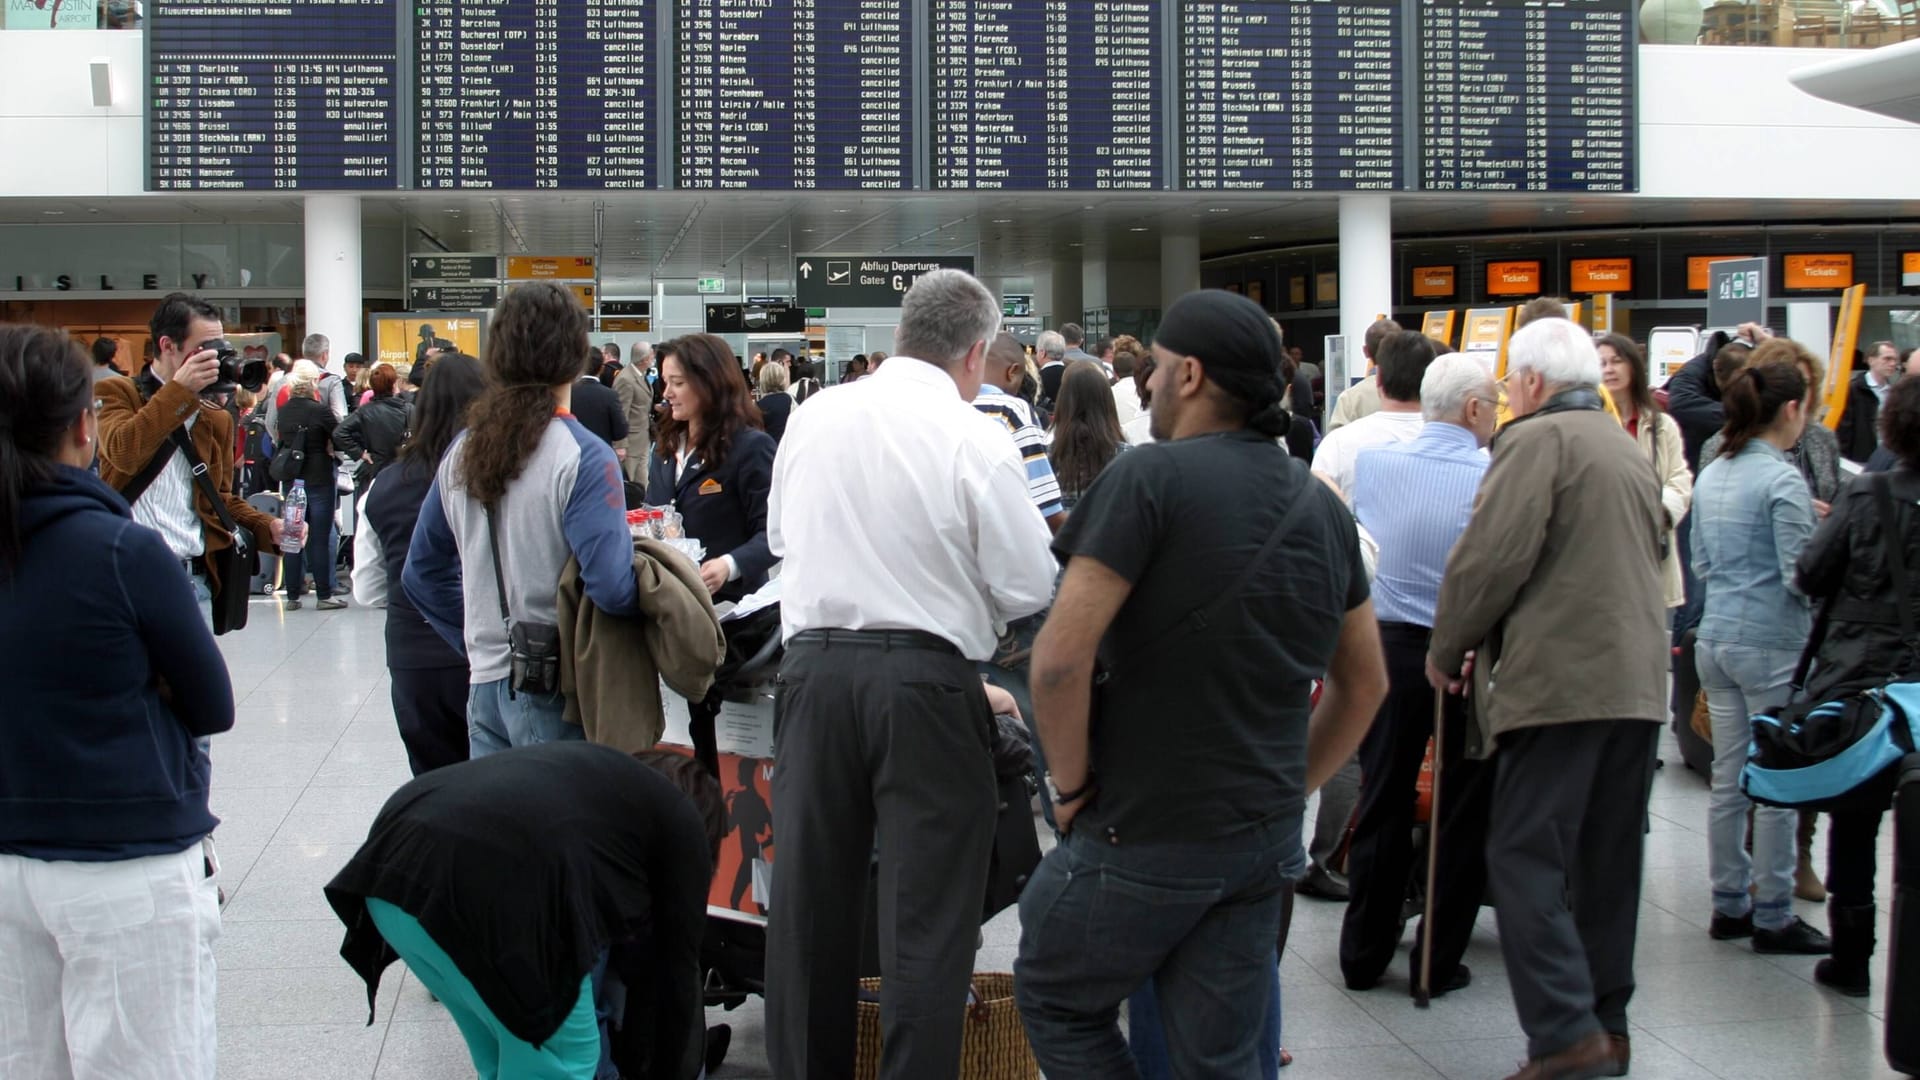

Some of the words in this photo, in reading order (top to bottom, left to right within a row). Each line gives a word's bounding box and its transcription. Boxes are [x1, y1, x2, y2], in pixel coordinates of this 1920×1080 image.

[59, 15, 91, 23] AIRPORT
[440, 19, 452, 27] 132
[535, 19, 557, 28] 13:15
[681, 32, 691, 40] LH
[698, 32, 712, 40] 940
[720, 33, 759, 41] Nuremberg
[793, 33, 815, 41] 14:35
[936, 34, 946, 43] LH
[949, 34, 967, 43] 4074
[974, 35, 1009, 43] Florence
[1046, 35, 1067, 44] 15:00
[1111, 36, 1149, 44] Lufthansa
[1424, 30, 1433, 38] LH
[1586, 33, 1622, 41] cancelled
[421, 42, 431, 50] LH
[460, 42, 504, 50] Dusseldorf
[536, 42, 557, 51] 13:15
[1185, 37, 1194, 45] LH
[1197, 37, 1215, 45] 3144
[1221, 37, 1239, 45] Oslo
[1291, 38, 1311, 47] 15:15
[1424, 40, 1433, 48] LH
[1459, 41, 1484, 49] Prague
[1586, 44, 1622, 52] cancelled
[421, 53, 431, 61] LH
[435, 53, 453, 61] 1270
[536, 54, 557, 62] 13:15
[159, 65, 169, 73] LH
[198, 65, 239, 73] Charlotte
[301, 65, 322, 73] 13:45
[343, 65, 383, 73] Lufthansa
[937, 68, 946, 76] LH
[950, 68, 967, 76] 1072
[975, 68, 1005, 77] Dresden
[1047, 69, 1067, 77] 15:05
[1112, 70, 1150, 78] cancelled
[681, 77, 691, 85] LH
[694, 77, 712, 86] 3114
[720, 78, 754, 86] Helsinki
[794, 78, 815, 86] 14:45
[861, 79, 900, 87] cancelled
[439, 87, 452, 96] 327
[536, 88, 557, 96] 13:35
[604, 88, 635, 96] 304-310
[159, 99, 169, 107] TP
[176, 99, 191, 107] 557
[274, 99, 296, 107] 12:55
[159, 111, 169, 119] LH
[199, 111, 222, 119] Sofia
[274, 110, 296, 119] 13:00
[344, 111, 384, 119] Lufthansa
[937, 113, 947, 121] LH
[975, 113, 1014, 121] Paderborn
[1047, 113, 1068, 121] 15:05
[1112, 114, 1150, 122] cancelled
[681, 134, 691, 142] LH
[695, 134, 712, 142] 3314
[794, 134, 815, 143] 14:45
[1186, 136, 1195, 144] LH
[1292, 136, 1313, 145] 15:25
[421, 145, 431, 153] LX
[461, 145, 488, 153] Zurich
[536, 145, 557, 153] 14:05
[938, 157, 947, 166] LH
[976, 158, 1002, 166] Bremen
[1048, 158, 1068, 166] 15:15
[1113, 158, 1151, 166] cancelled
[159, 168, 169, 177] LH
[173, 168, 191, 176] 1024
[274, 168, 296, 176] 13:10
[344, 168, 387, 176] annulliert
[159, 180, 169, 188] SK
[199, 180, 244, 188] Kopenhagen
[275, 180, 297, 188] 13:10
[682, 180, 691, 188] LH
[695, 179, 713, 188] 3170
[720, 180, 747, 188] Poznan
[794, 180, 815, 188] 14:55
[1187, 180, 1196, 188] LH
[1293, 180, 1313, 189] 15:25
[1356, 181, 1392, 189] cancelled
[860, 261, 890, 273] Abflug
[891, 261, 940, 273] Departures
[1804, 267, 1839, 276] Tickets
[860, 275, 886, 286] Gates
[1502, 275, 1529, 283] Tickets
[1587, 272, 1619, 280] Tickets
[380, 350, 410, 360] Airport
